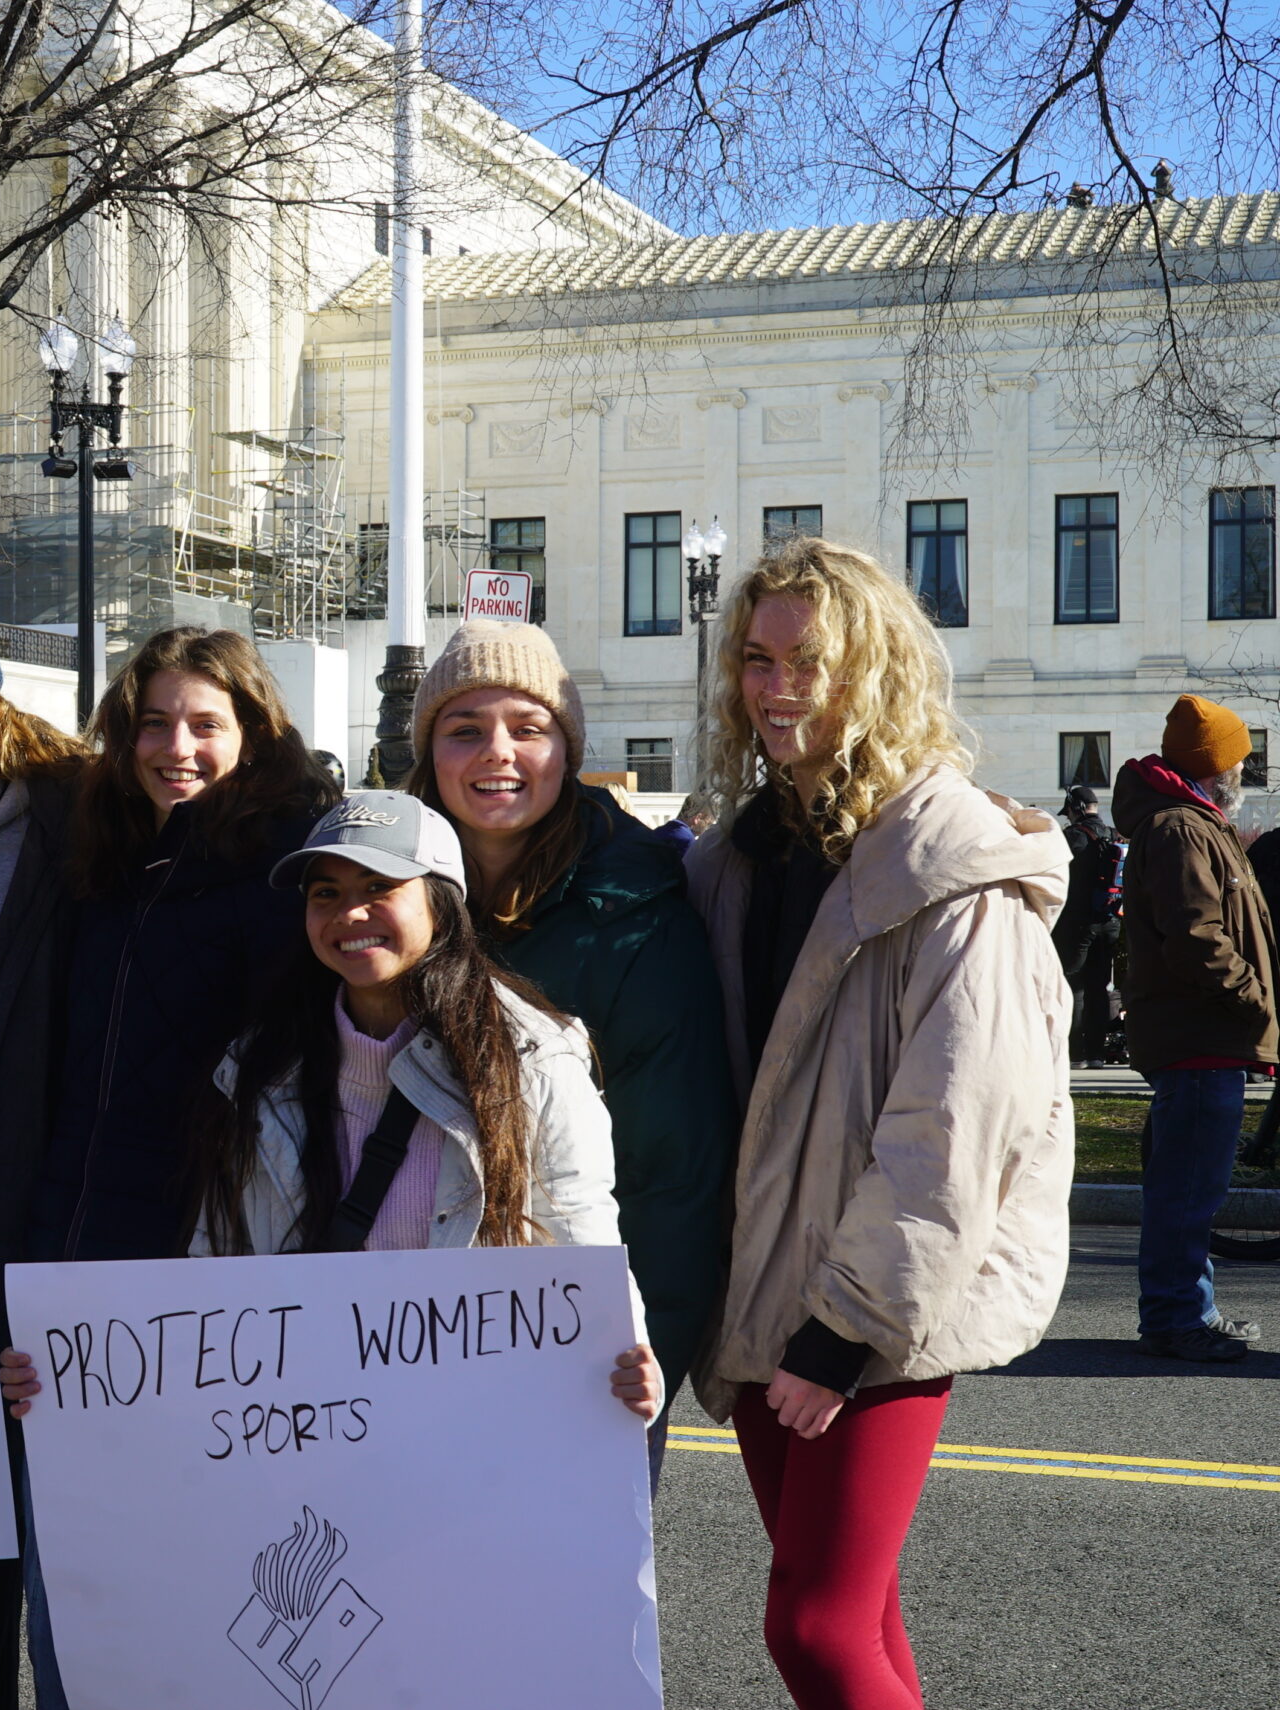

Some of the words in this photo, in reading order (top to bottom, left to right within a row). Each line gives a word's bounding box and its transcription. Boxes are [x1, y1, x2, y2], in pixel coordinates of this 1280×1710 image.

[471, 597, 523, 617] PARKING
[487, 579, 510, 597] NO
[46, 1305, 304, 1411] PROTECT
[352, 1278, 582, 1371] WOMEN'S
[205, 1398, 372, 1460] SPORTS
